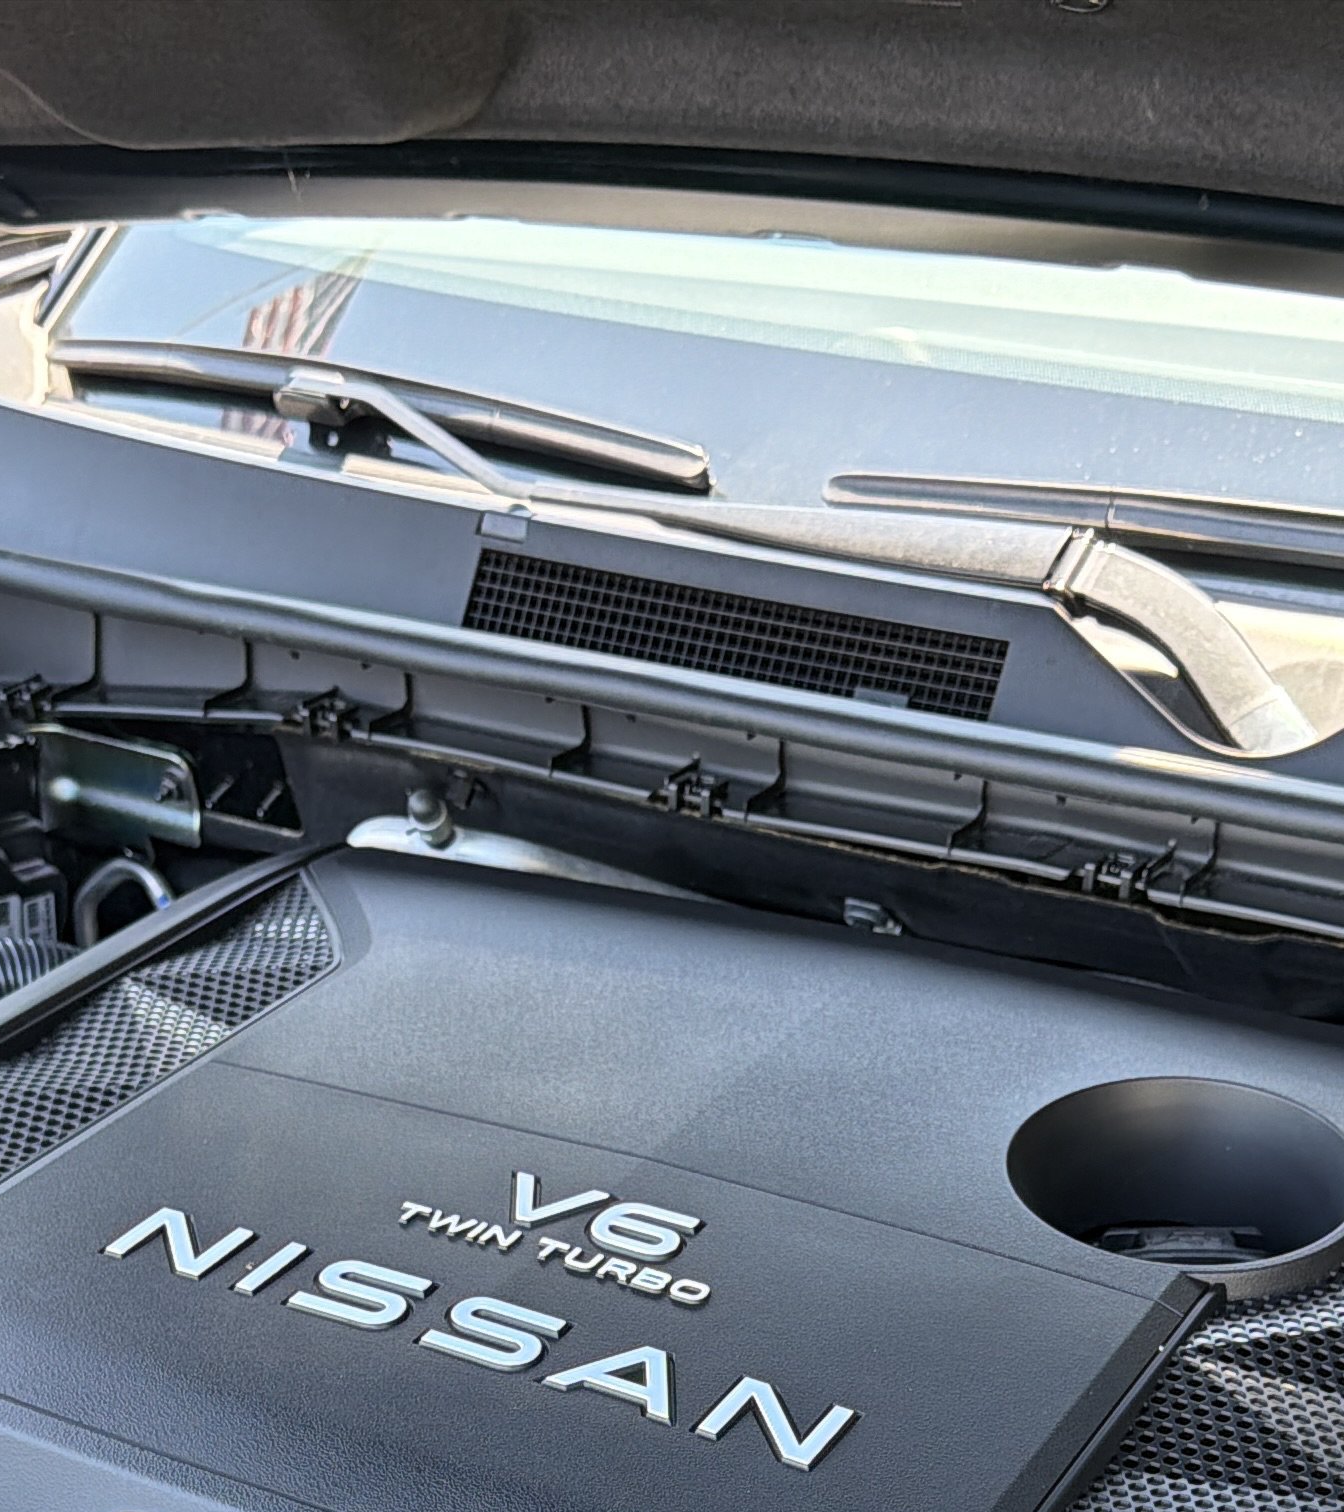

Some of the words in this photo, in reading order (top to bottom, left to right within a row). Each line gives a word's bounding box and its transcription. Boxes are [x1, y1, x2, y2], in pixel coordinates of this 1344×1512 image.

[399, 1201, 523, 1251] TWIN
[537, 1236, 712, 1306] TURBO
[512, 1169, 703, 1261] V6
[101, 1206, 861, 1472] NISSAN
